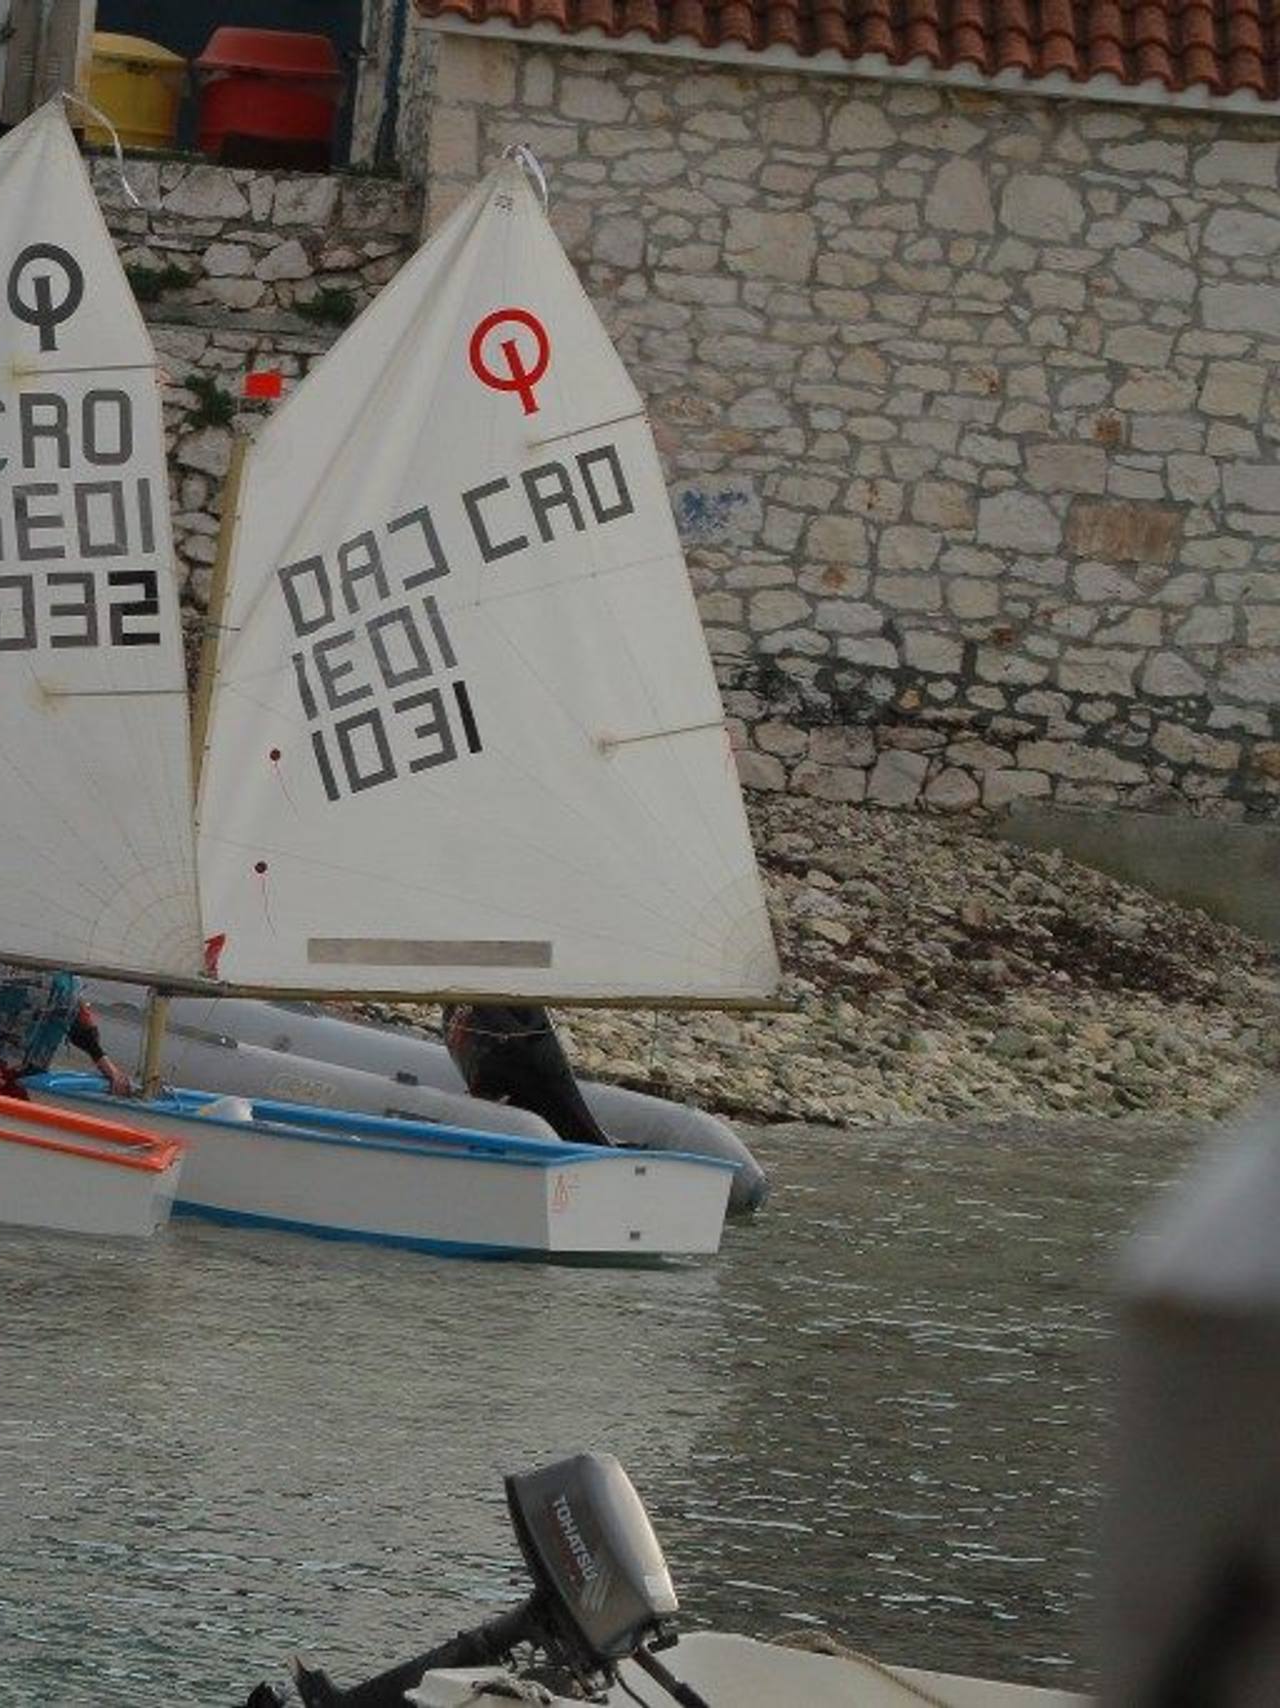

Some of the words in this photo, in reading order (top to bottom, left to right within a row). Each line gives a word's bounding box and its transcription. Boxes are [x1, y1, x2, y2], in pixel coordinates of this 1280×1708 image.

[462, 444, 636, 563] CRO
[311, 680, 483, 802] 1031
[552, 1494, 599, 1582] TOHATSU
